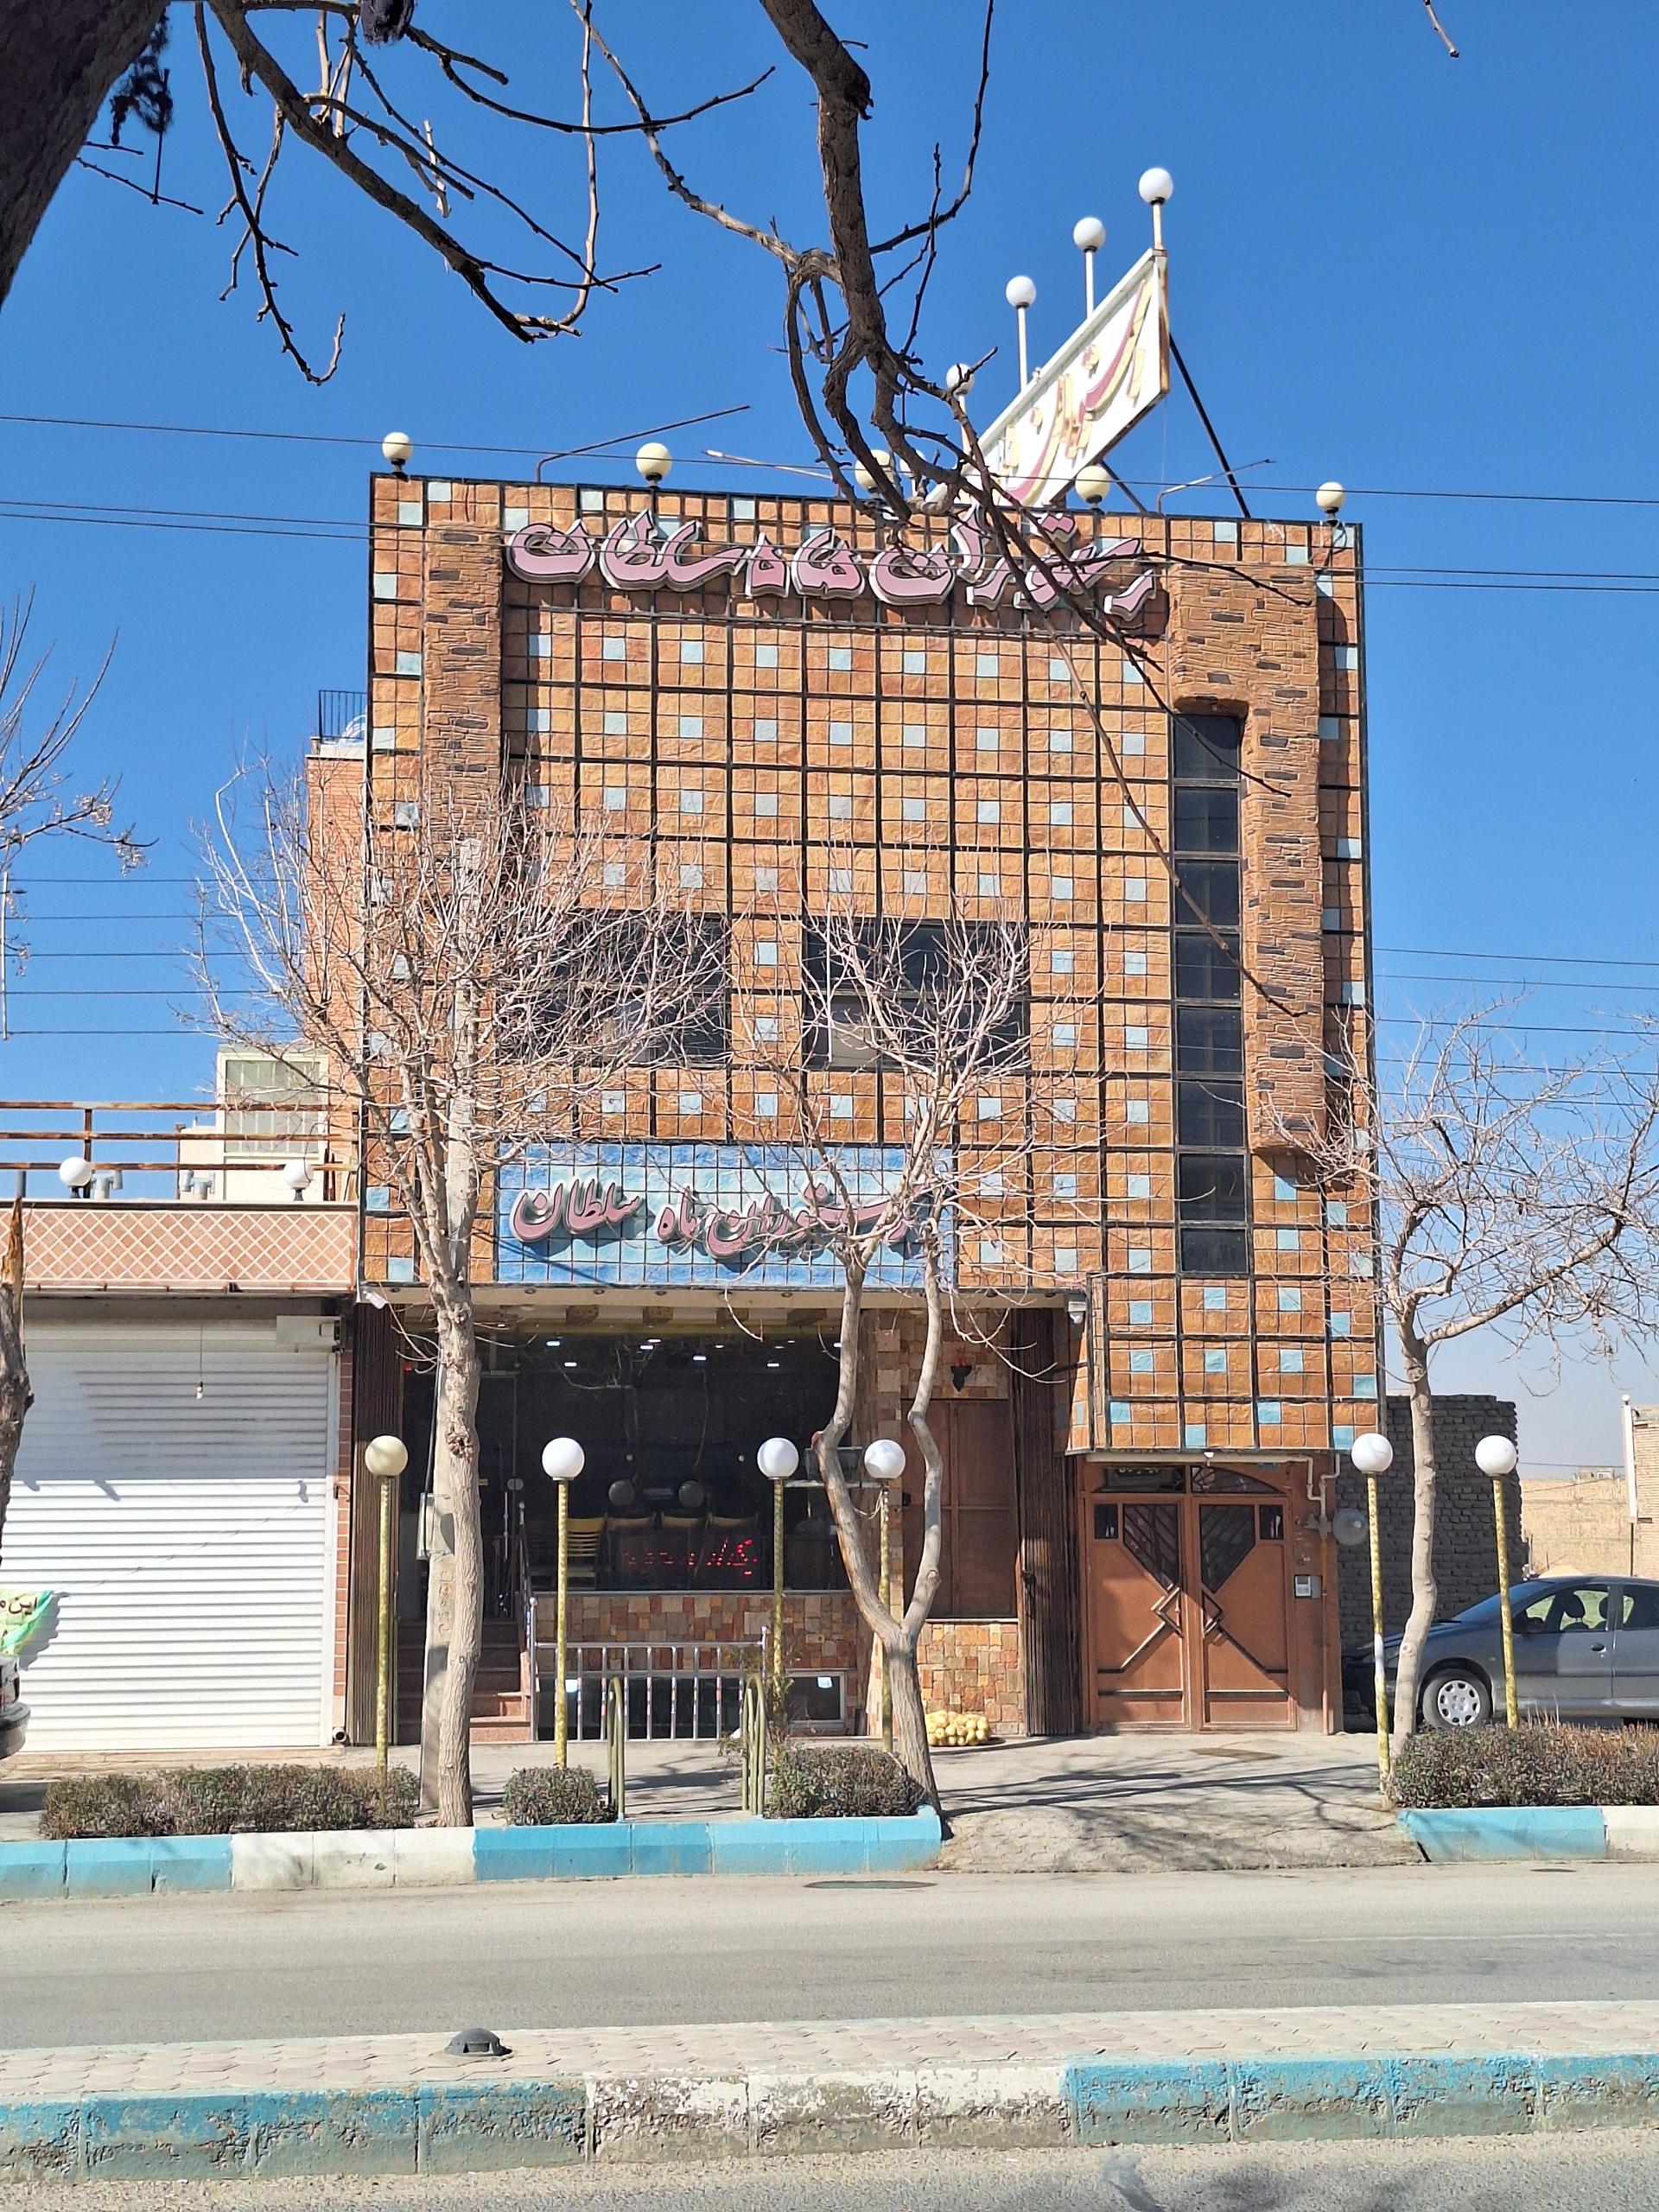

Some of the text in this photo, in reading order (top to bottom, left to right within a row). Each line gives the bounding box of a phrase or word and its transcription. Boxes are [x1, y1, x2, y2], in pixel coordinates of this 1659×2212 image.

[506, 505, 1156, 620] رستوران ماه سلطان
[511, 1178, 929, 1258] رستوران ماه سلطان
[9, 1596, 38, 1616] این
